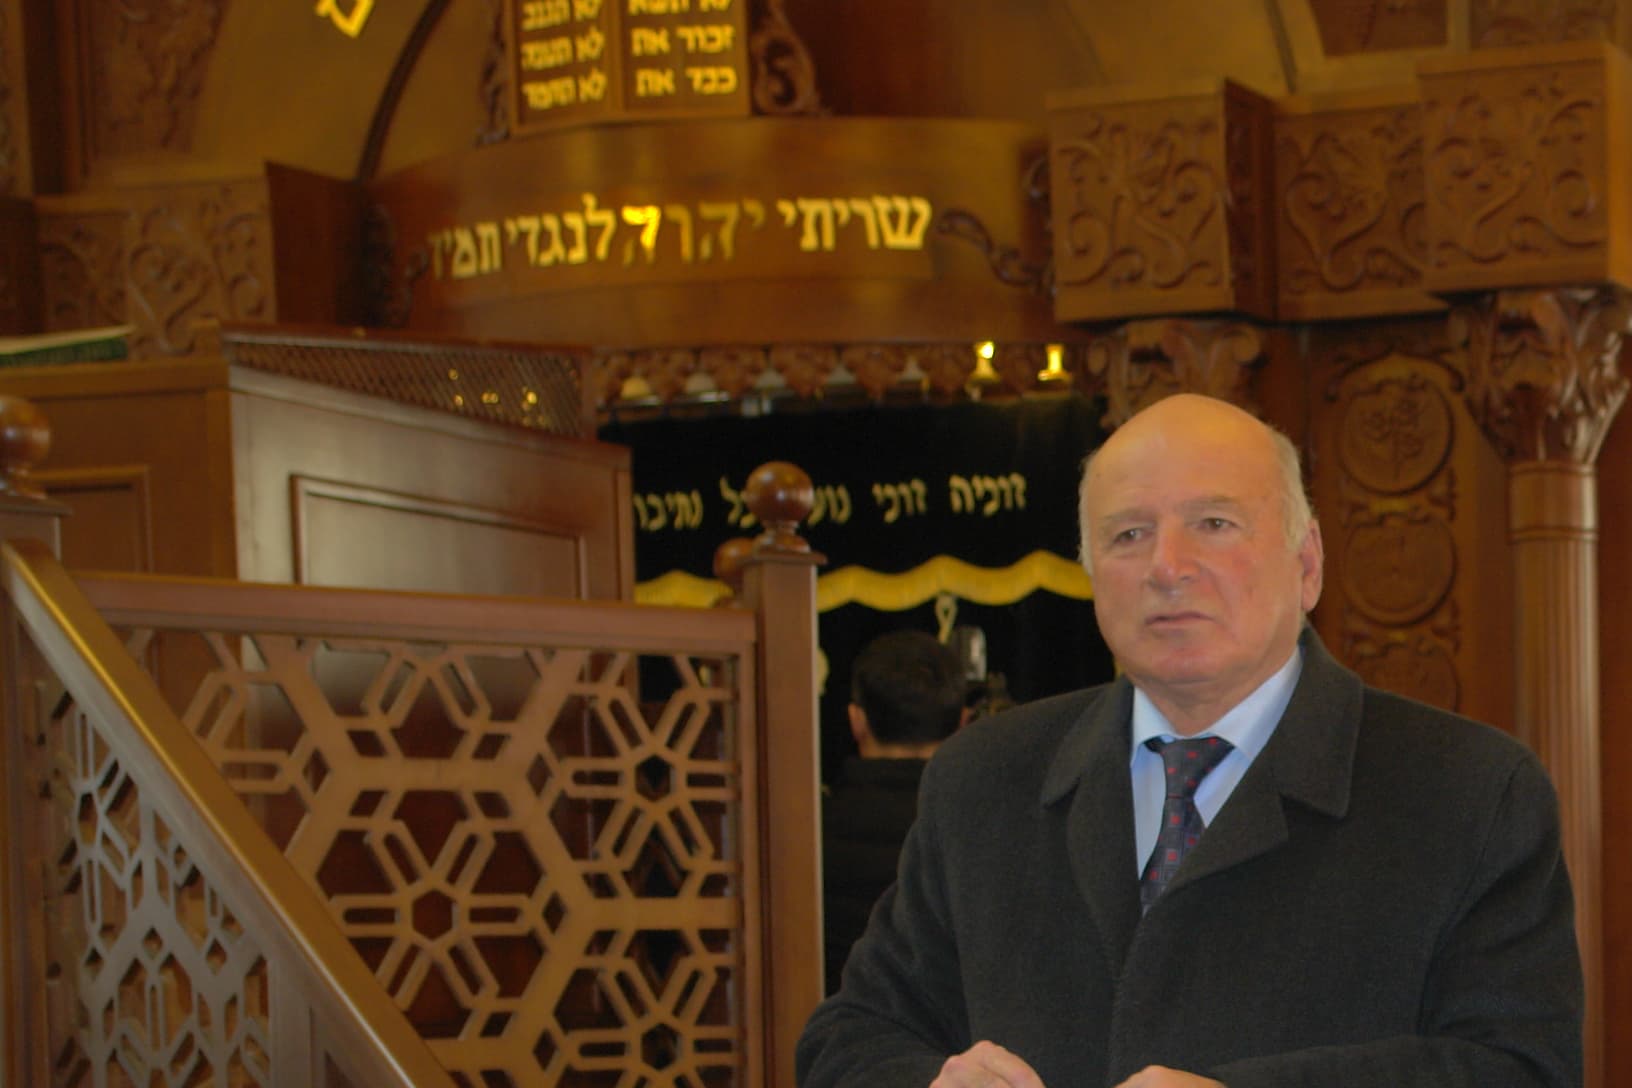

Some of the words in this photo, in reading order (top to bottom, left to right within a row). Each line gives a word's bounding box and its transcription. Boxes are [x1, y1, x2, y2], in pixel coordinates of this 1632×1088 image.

[575, 24, 606, 62] לא
[631, 27, 671, 57] את
[674, 23, 736, 54] זכור
[579, 68, 608, 103] לא
[635, 67, 676, 98] את
[684, 65, 738, 96] כבד
[503, 191, 617, 267] לנגדי
[621, 198, 766, 267] יהוה
[428, 221, 502, 281] תמיד
[633, 488, 704, 531] נתיבו
[807, 482, 852, 528] נוע
